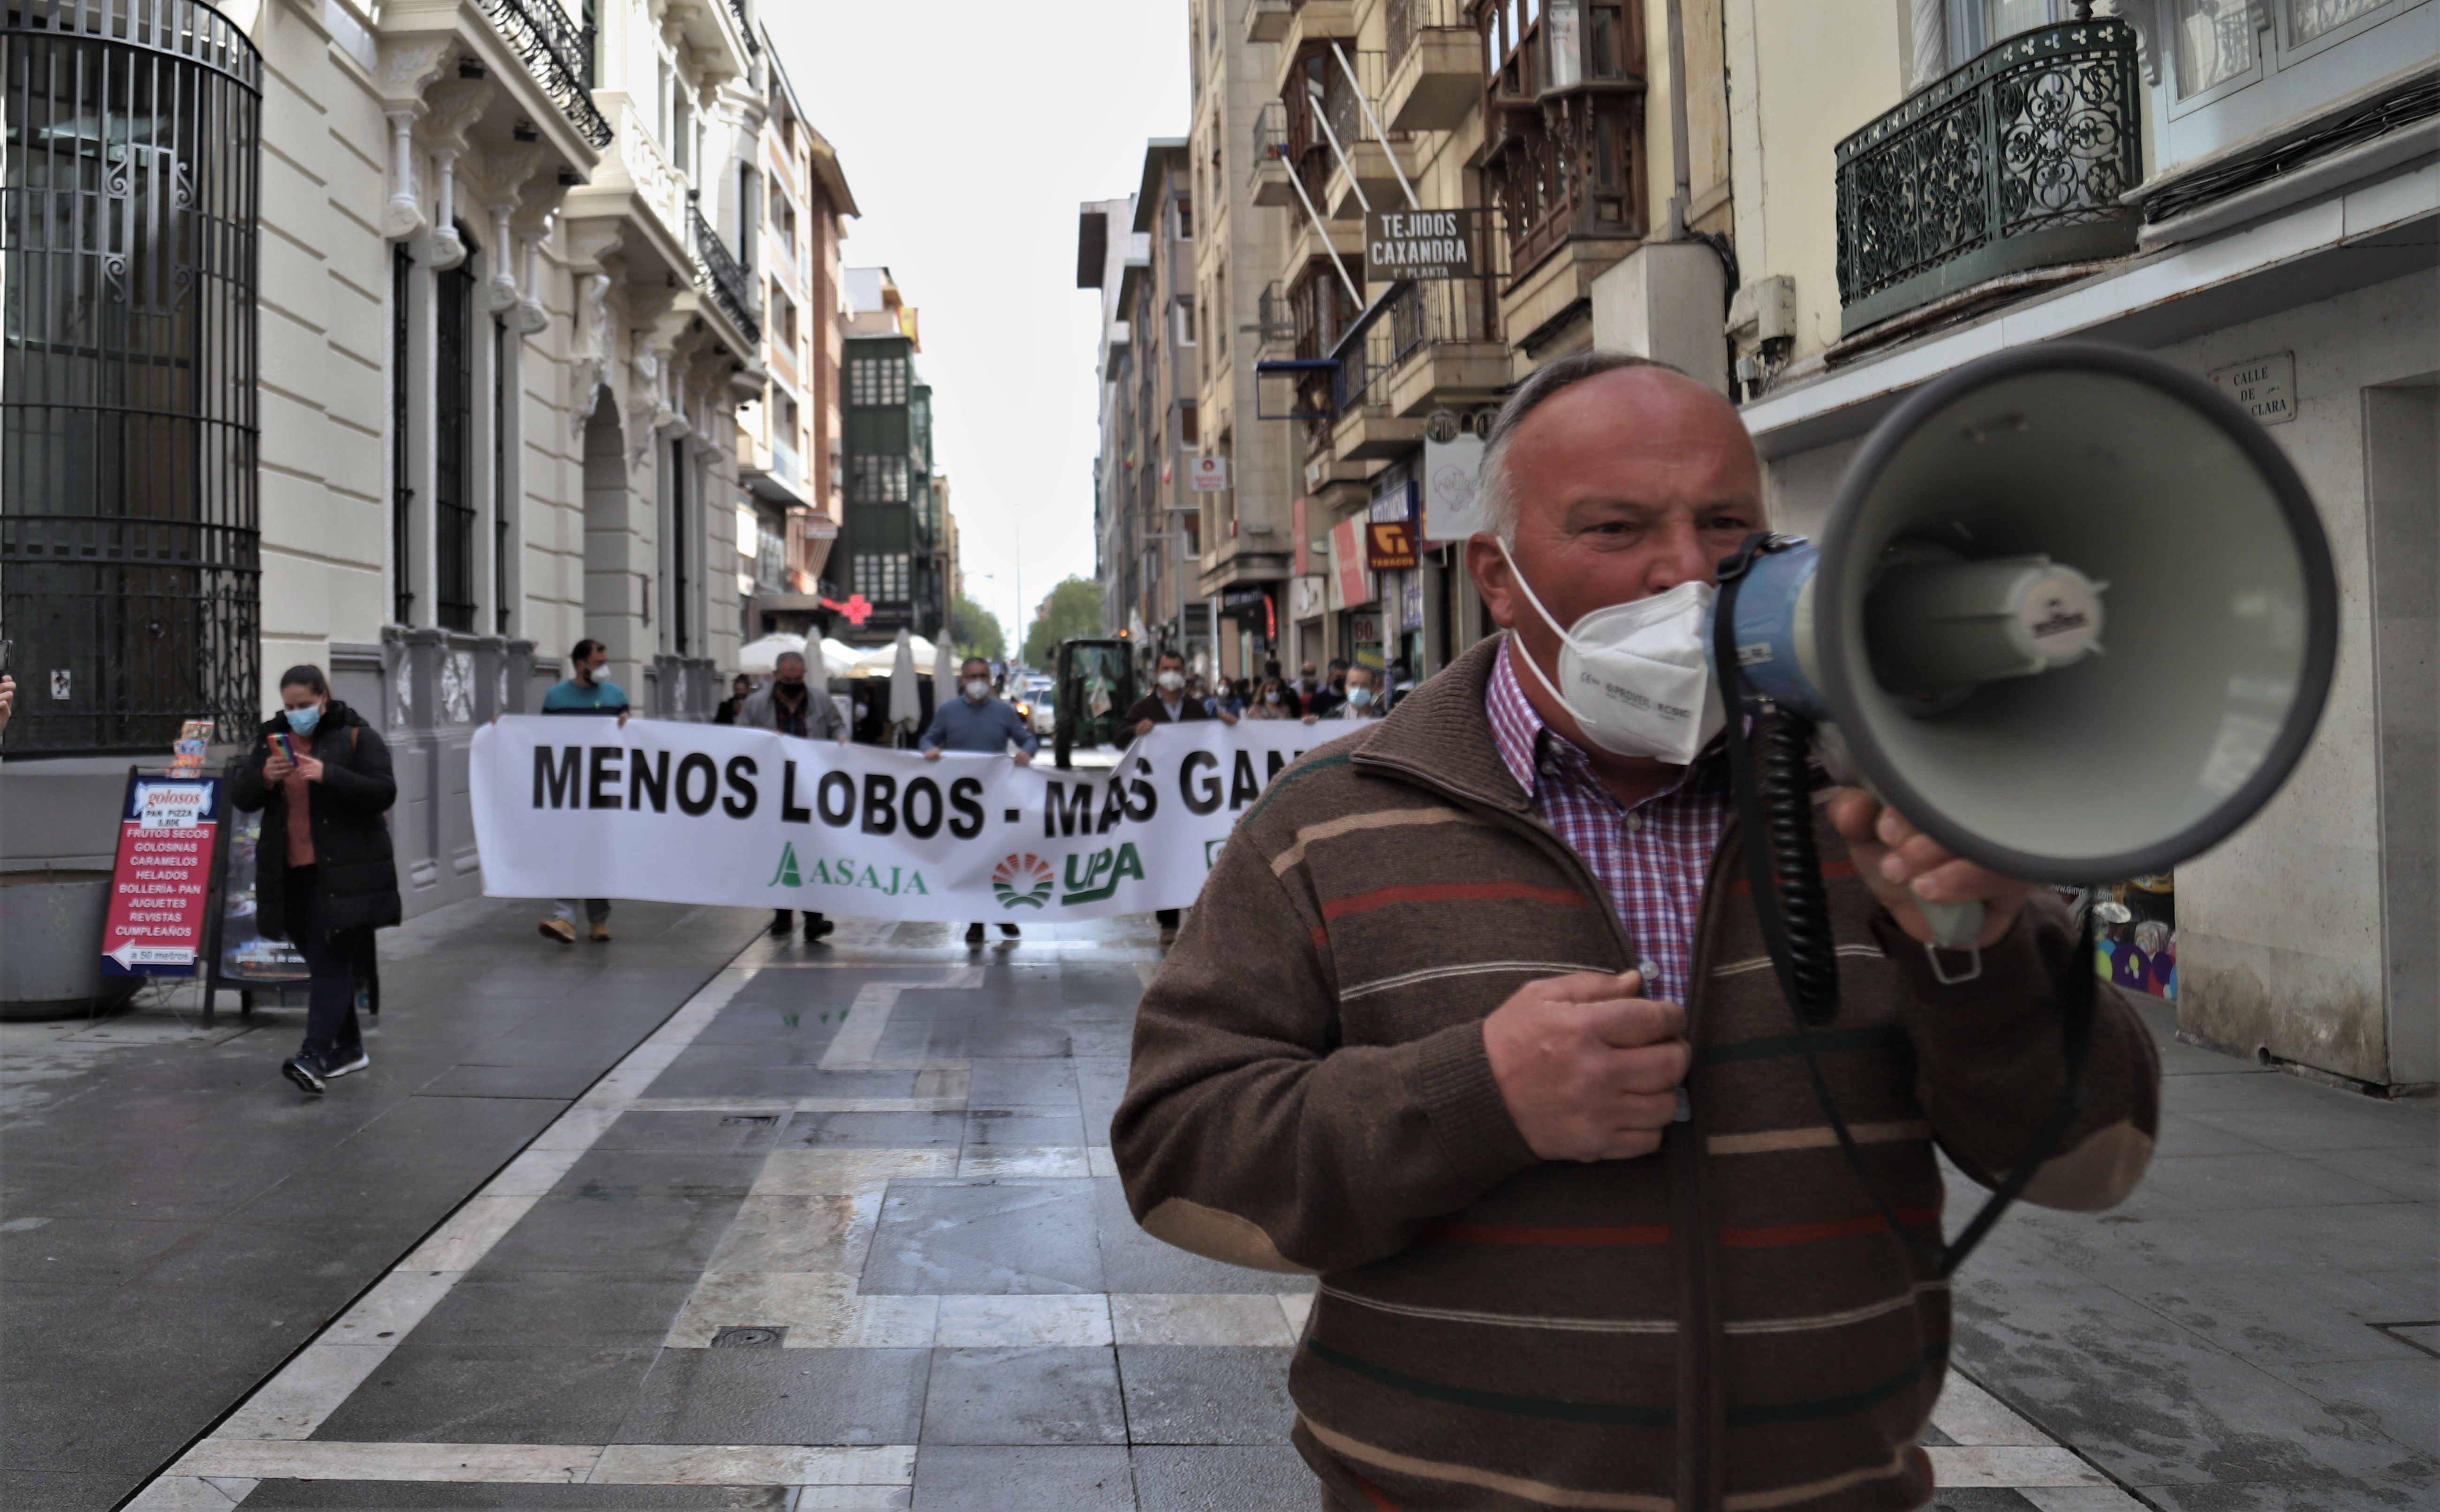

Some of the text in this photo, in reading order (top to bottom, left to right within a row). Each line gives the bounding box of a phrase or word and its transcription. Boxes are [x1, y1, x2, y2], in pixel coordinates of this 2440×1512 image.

[1381, 212, 1457, 238] TEJIDOS
[1372, 239, 1468, 265] CAXANDRA
[1407, 265, 1449, 279] PLANTA
[2233, 366, 2268, 386] CALLE
[2240, 388, 2255, 401] DE
[2251, 399, 2287, 416] CLARA
[1372, 558, 1415, 567] TABACOS
[145, 789, 200, 809] golosos
[533, 746, 758, 820] MENOS
[782, 760, 985, 840] LOBOS
[1045, 757, 1158, 839] MAS
[127, 829, 210, 839] FRUTOS SECOS
[134, 843, 198, 852] GOLOSINAS
[130, 856, 198, 867] CARAMELOS
[135, 870, 189, 880] HELADOS
[810, 859, 930, 895] ASAJA
[1061, 842, 1145, 906] UPA
[178, 885, 201, 894] PAN
[128, 899, 187, 908] JUGUETES
[129, 912, 182, 922] REVISTAS
[115, 926, 192, 937] CUMPLEAÑOS
[140, 951, 152, 960] 50
[155, 951, 189, 960] metros
